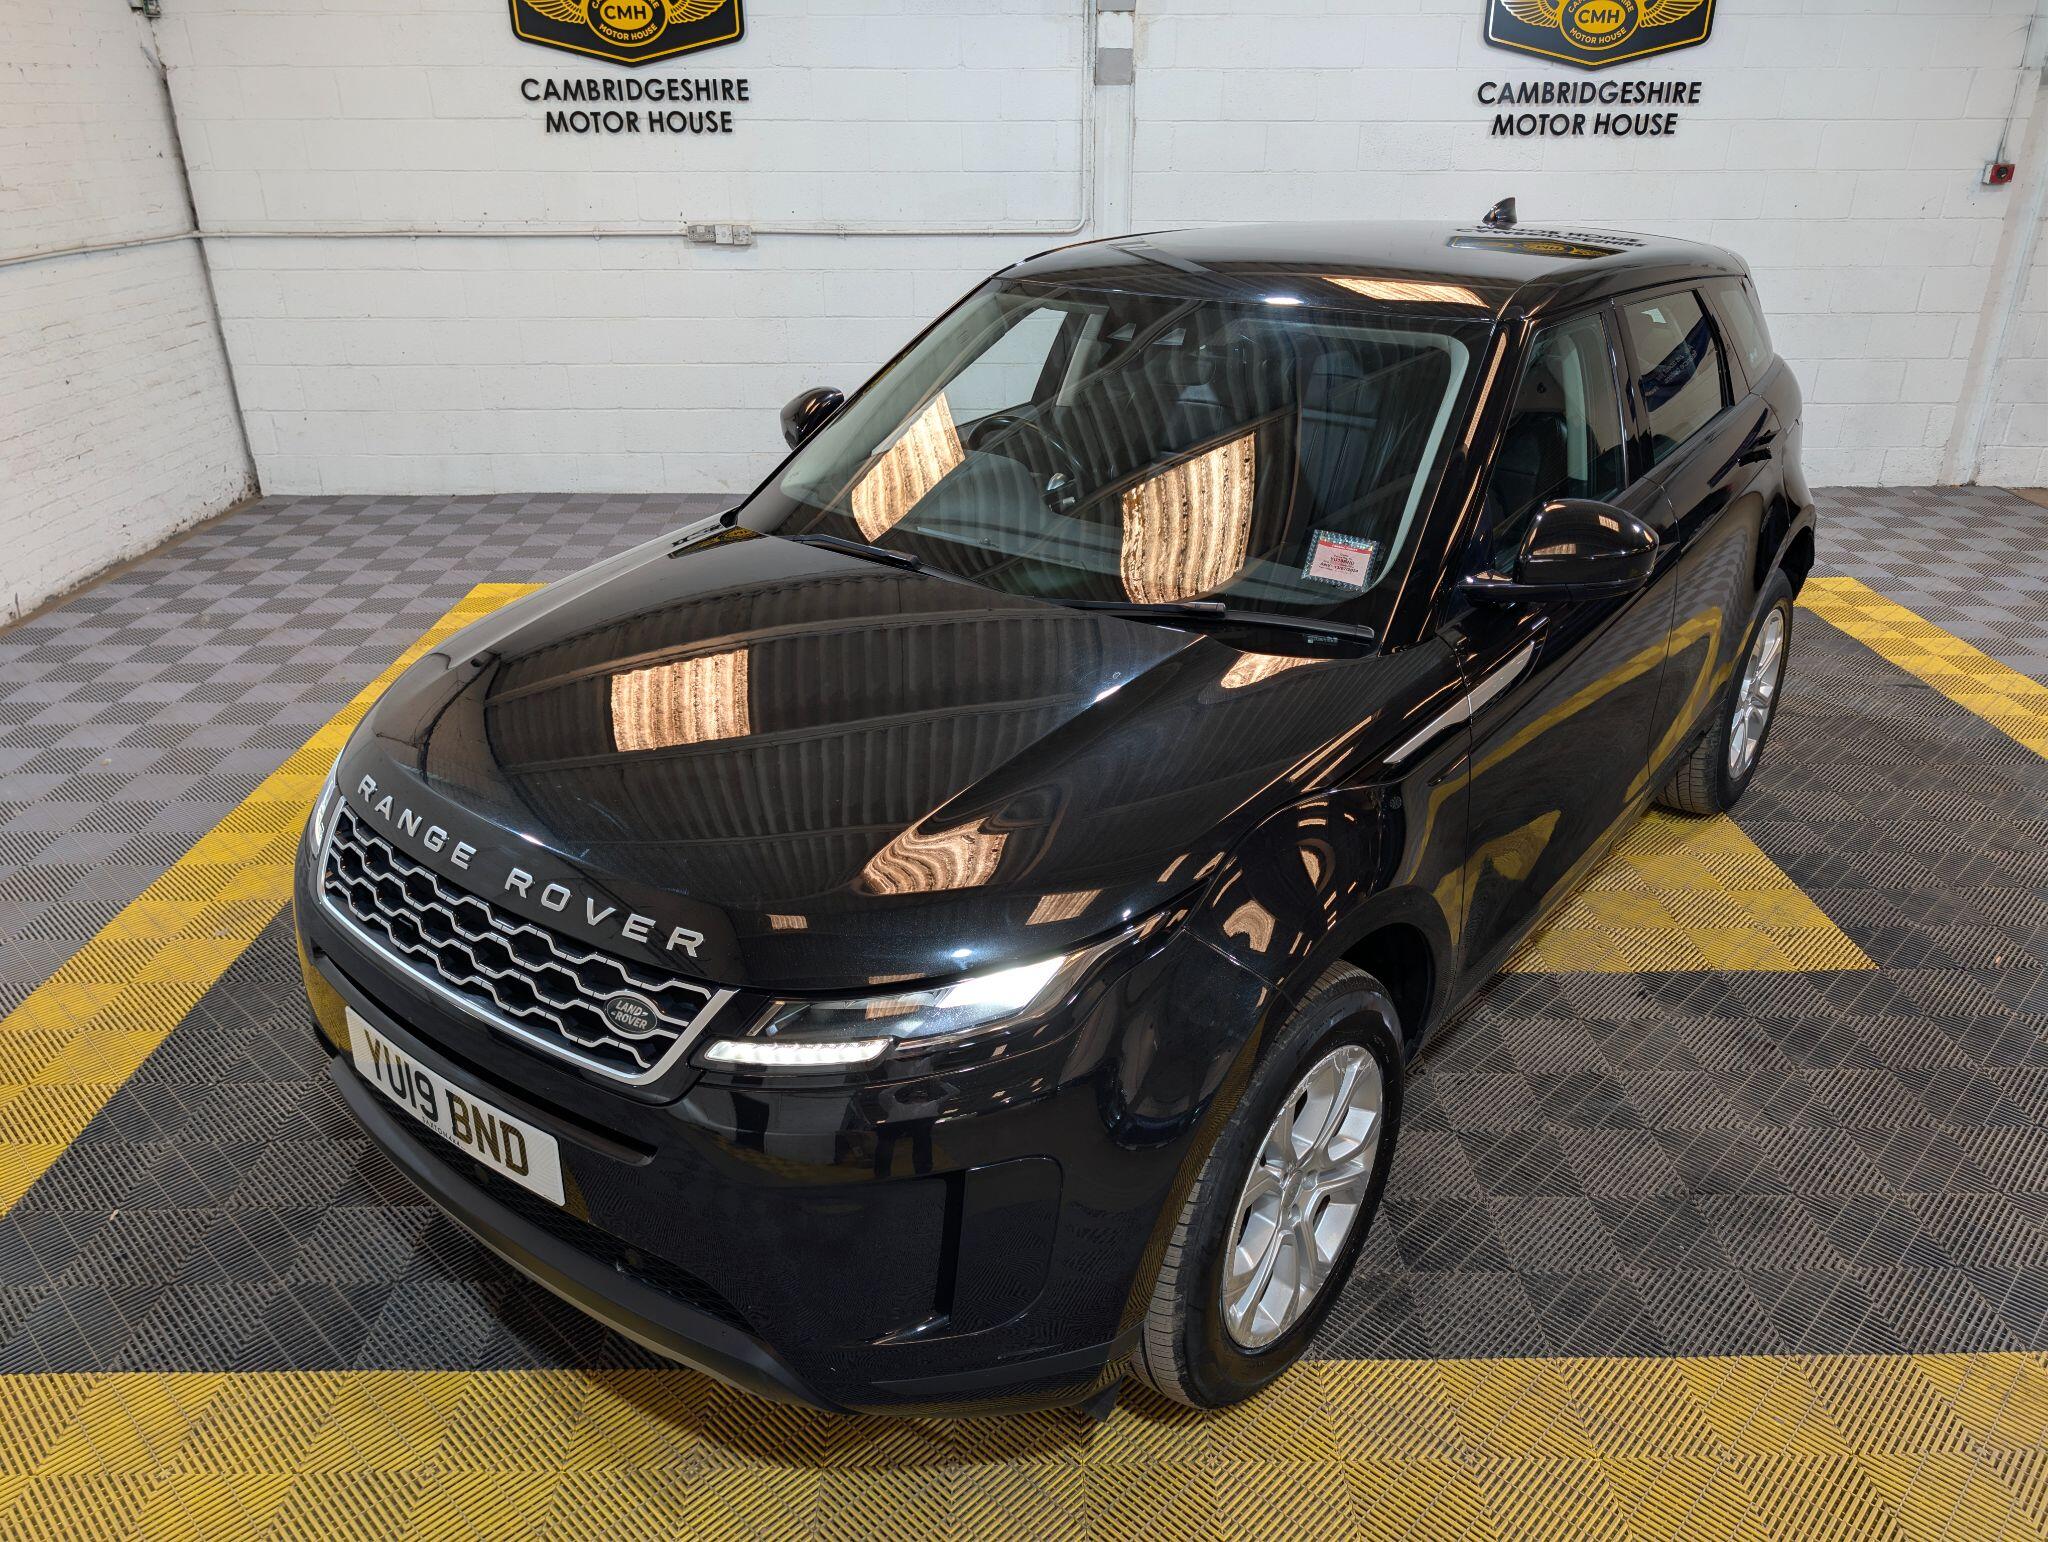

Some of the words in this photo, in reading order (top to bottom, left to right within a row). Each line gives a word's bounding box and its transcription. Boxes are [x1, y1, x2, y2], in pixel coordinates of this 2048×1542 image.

[604, 5, 647, 20] CMH
[1578, 9, 1620, 24] CMH
[599, 23, 629, 40] MOTOR
[631, 23, 658, 40] HOUSE
[1570, 27, 1597, 44] MOTOR
[1599, 27, 1627, 44] HOUSE
[521, 78, 750, 102] CAMBRIDGESHIRE
[1477, 80, 1702, 105] CAMBRIDGESHIRE
[546, 110, 641, 133] MOTOR
[649, 110, 733, 133] HOUSE
[1491, 113, 1586, 136] MOTOR
[1593, 112, 1678, 136] HOUSE
[357, 774, 478, 871] RANGE
[504, 867, 705, 958] ROVER
[615, 1000, 643, 1016] LAND
[614, 1010, 648, 1029] ROVER
[364, 1029, 439, 1123] YU19
[445, 1089, 529, 1177] BND
